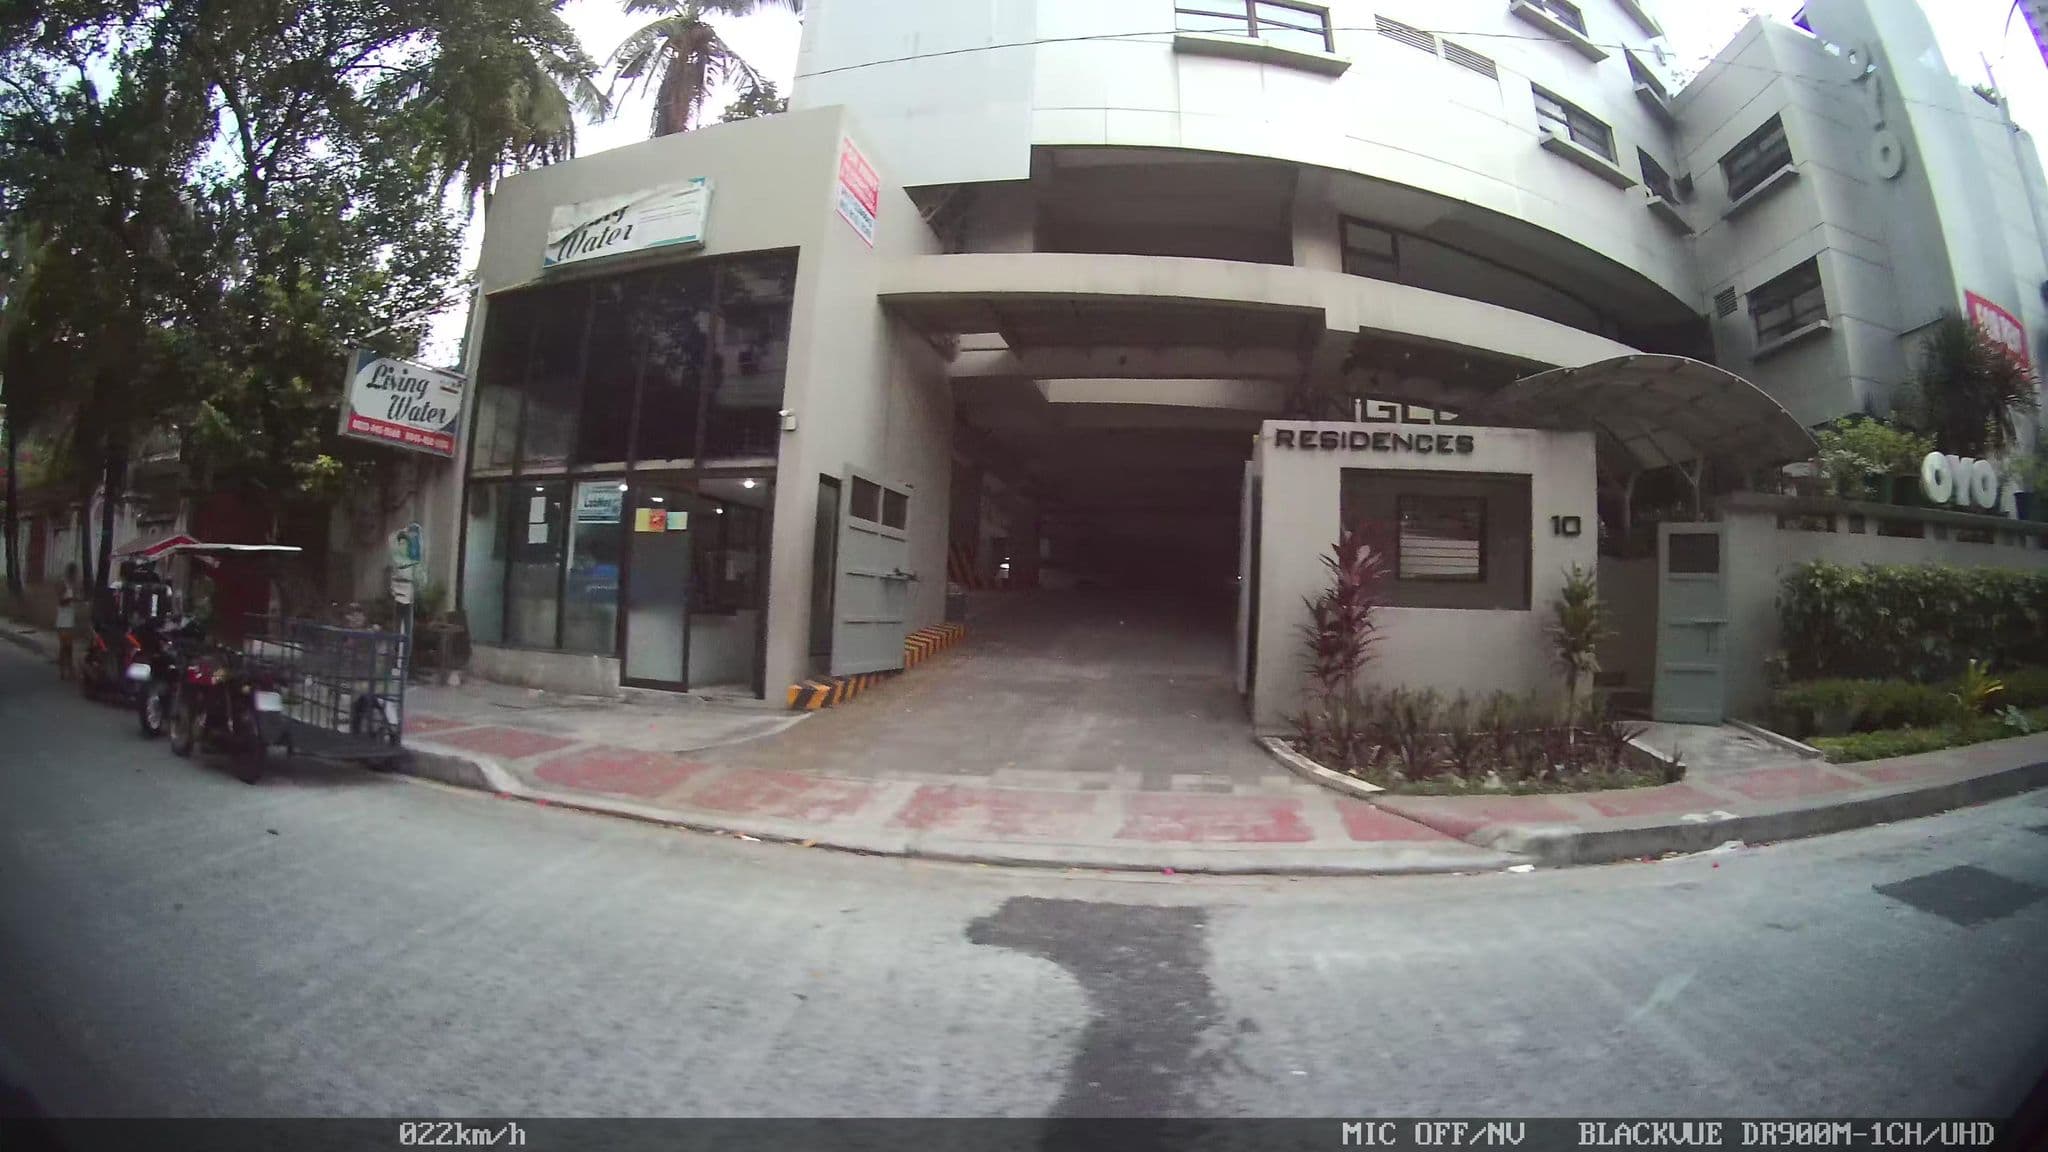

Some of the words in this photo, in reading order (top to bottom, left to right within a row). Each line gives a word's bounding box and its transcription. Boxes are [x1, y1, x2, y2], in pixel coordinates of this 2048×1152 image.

[366, 364, 430, 400] Living
[387, 394, 446, 424] Water
[1275, 429, 1475, 454] RESIDENCES
[1921, 451, 1997, 509] OYO
[1550, 515, 1581, 537] 10
